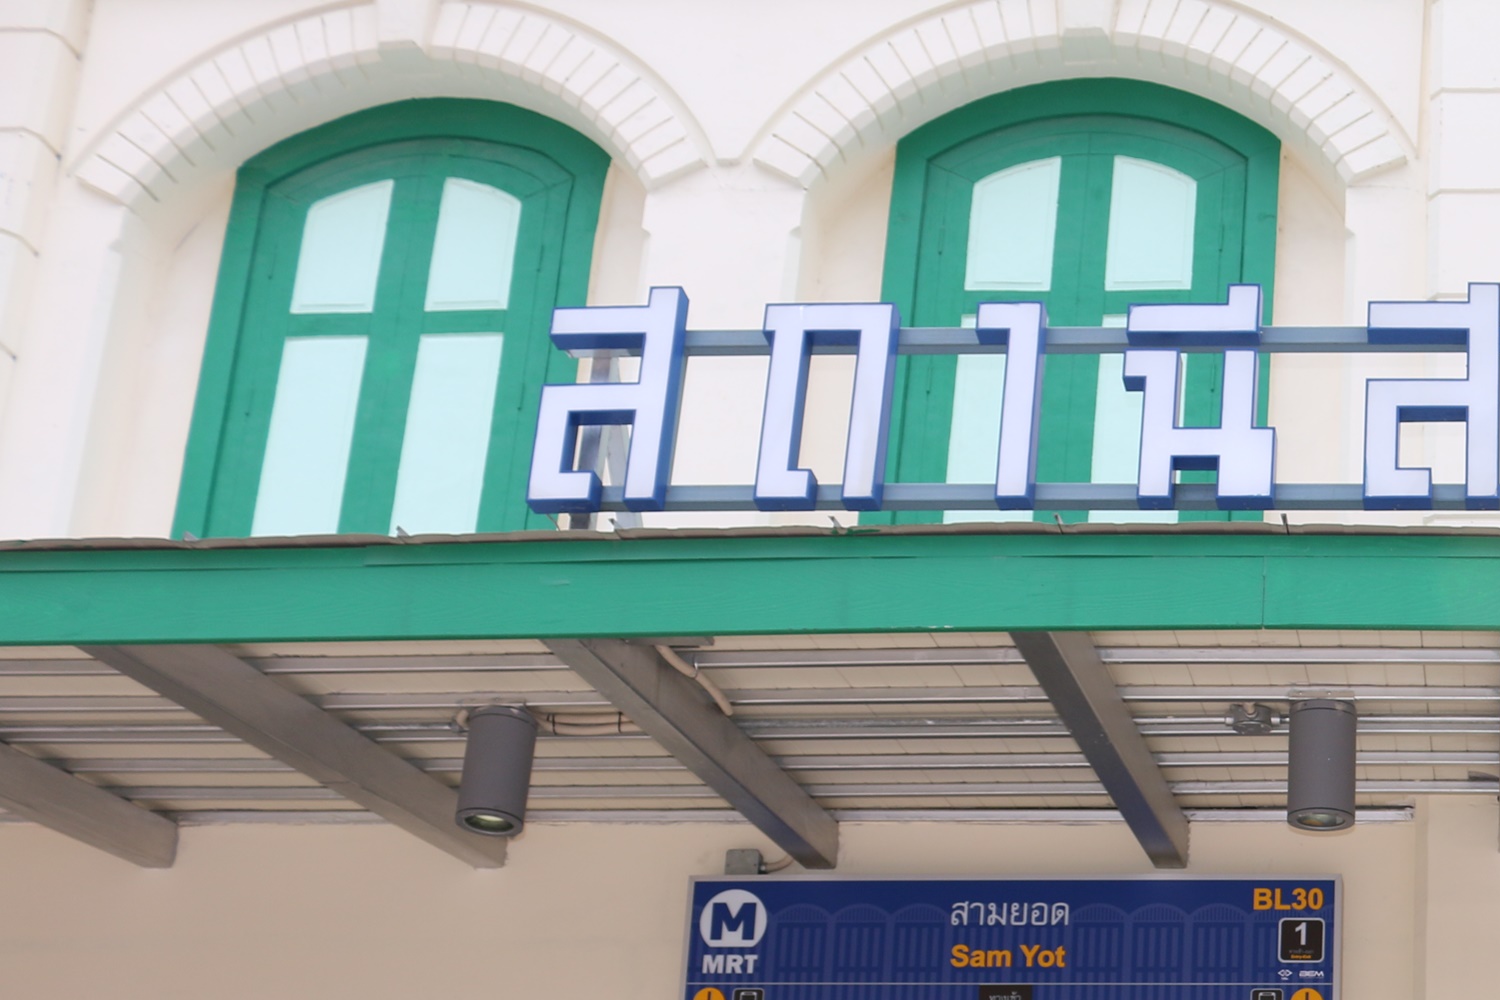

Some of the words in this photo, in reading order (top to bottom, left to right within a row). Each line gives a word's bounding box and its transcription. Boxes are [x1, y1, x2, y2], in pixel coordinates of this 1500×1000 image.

[1253, 887, 1324, 911] BL30
[709, 902, 758, 941] M
[950, 900, 1070, 926] สามยอด
[1294, 921, 1307, 946] 1
[701, 954, 759, 974] MRT
[950, 943, 1013, 968] Sam
[1019, 944, 1067, 968] Yot
